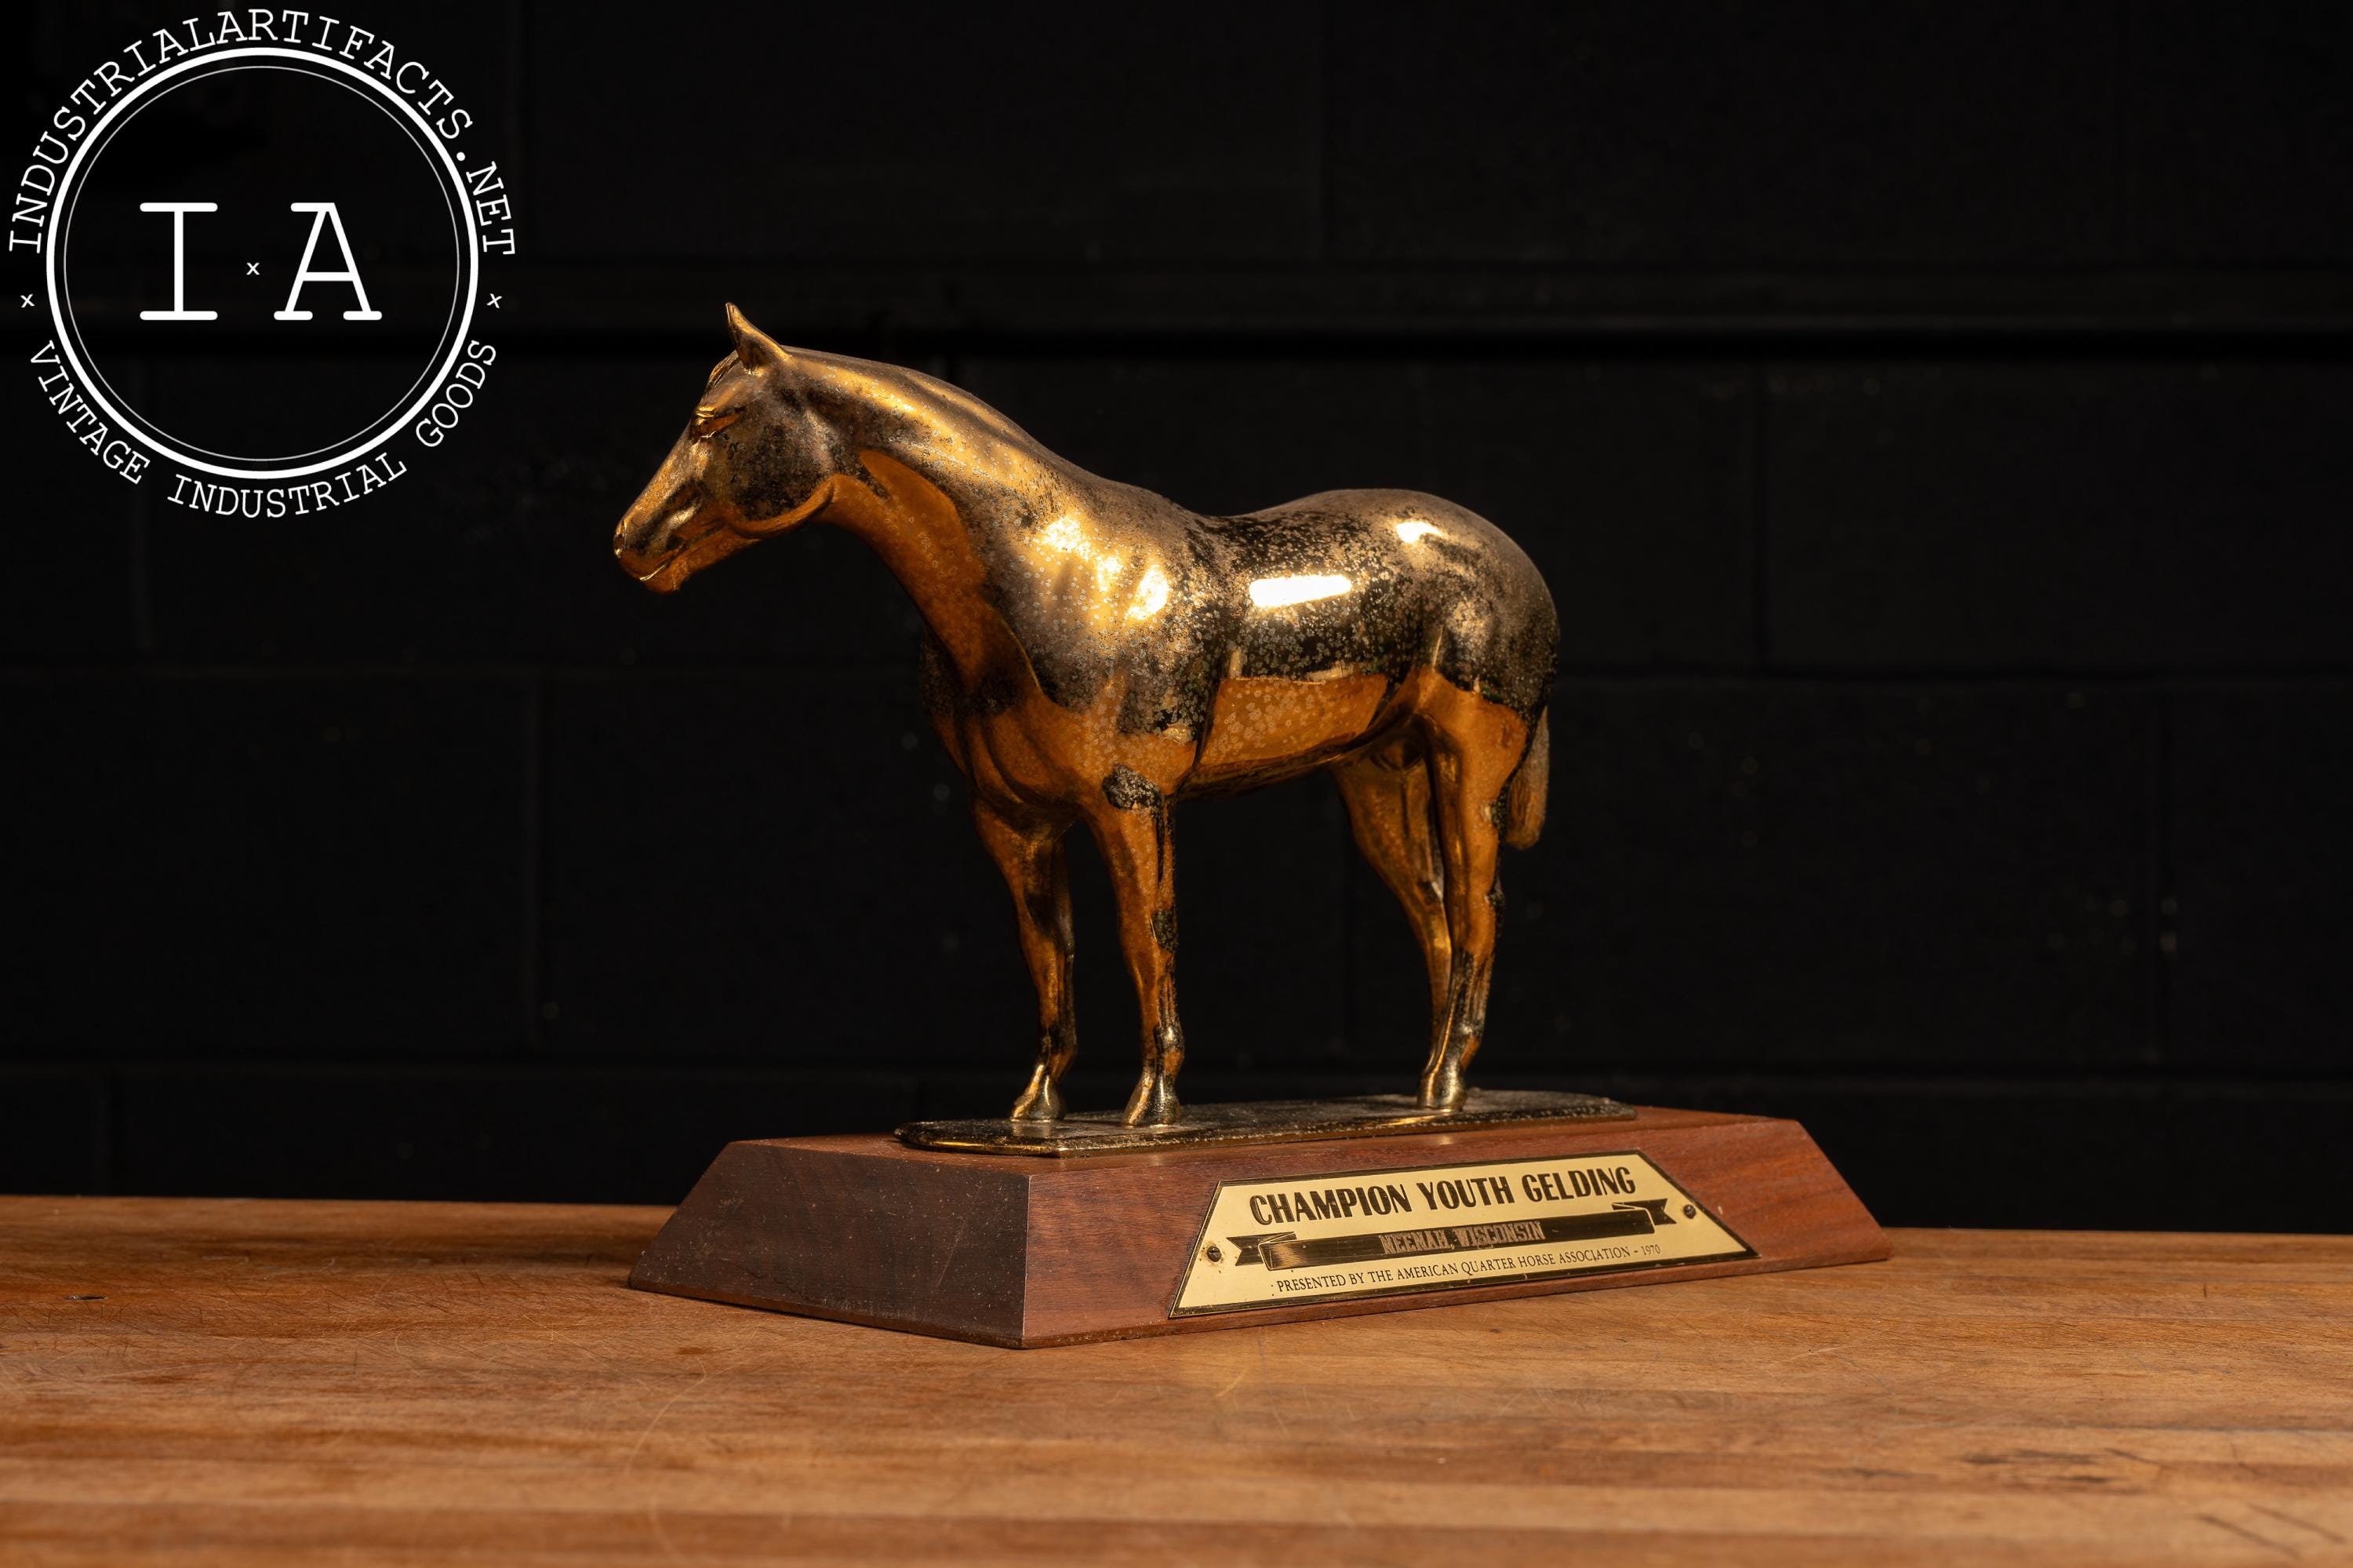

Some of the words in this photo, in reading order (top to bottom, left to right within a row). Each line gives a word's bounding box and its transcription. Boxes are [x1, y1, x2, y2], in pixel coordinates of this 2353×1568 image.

[1249, 1184, 1413, 1225] CHAMPION
[1417, 1180, 1515, 1210] YOUTH
[1522, 1166, 1636, 1202] GELDING
[1453, 1221, 1546, 1248] WISCONSIN
[1277, 1274, 1346, 1292] PRESENTED
[1351, 1271, 1366, 1284] BY
[1369, 1268, 1394, 1282] THE
[1398, 1263, 1459, 1279] AMERICAN
[1461, 1257, 1517, 1275] QUARTER
[1518, 1253, 1556, 1268] HORSE
[1559, 1246, 1631, 1264] ASSOCIATION
[1642, 1244, 1661, 1256] 1970
